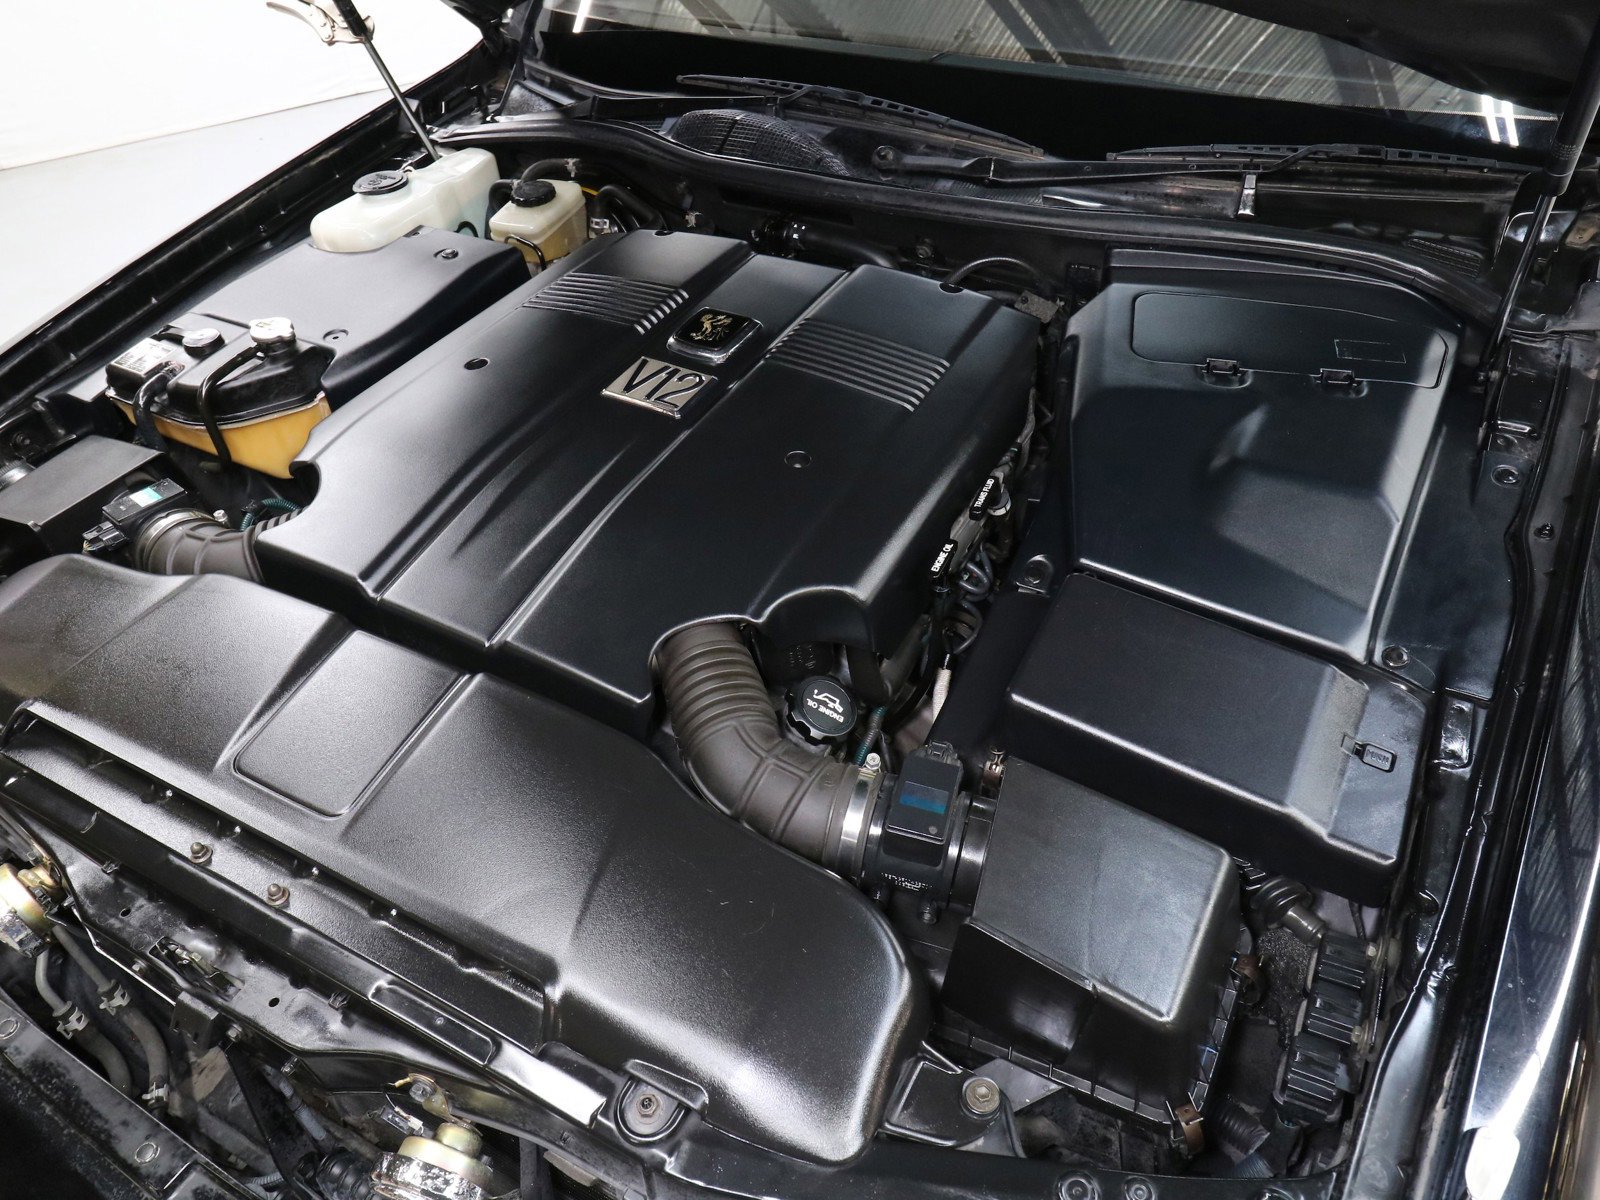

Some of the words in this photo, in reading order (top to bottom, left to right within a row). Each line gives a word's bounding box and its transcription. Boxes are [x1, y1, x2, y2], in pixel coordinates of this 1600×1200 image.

[621, 358, 706, 409] V12
[974, 491, 988, 507] TRANS
[982, 478, 995, 492] FLUID
[931, 551, 949, 572] ENGINE
[806, 698, 818, 709] OIL
[818, 704, 844, 723] ENGINE
